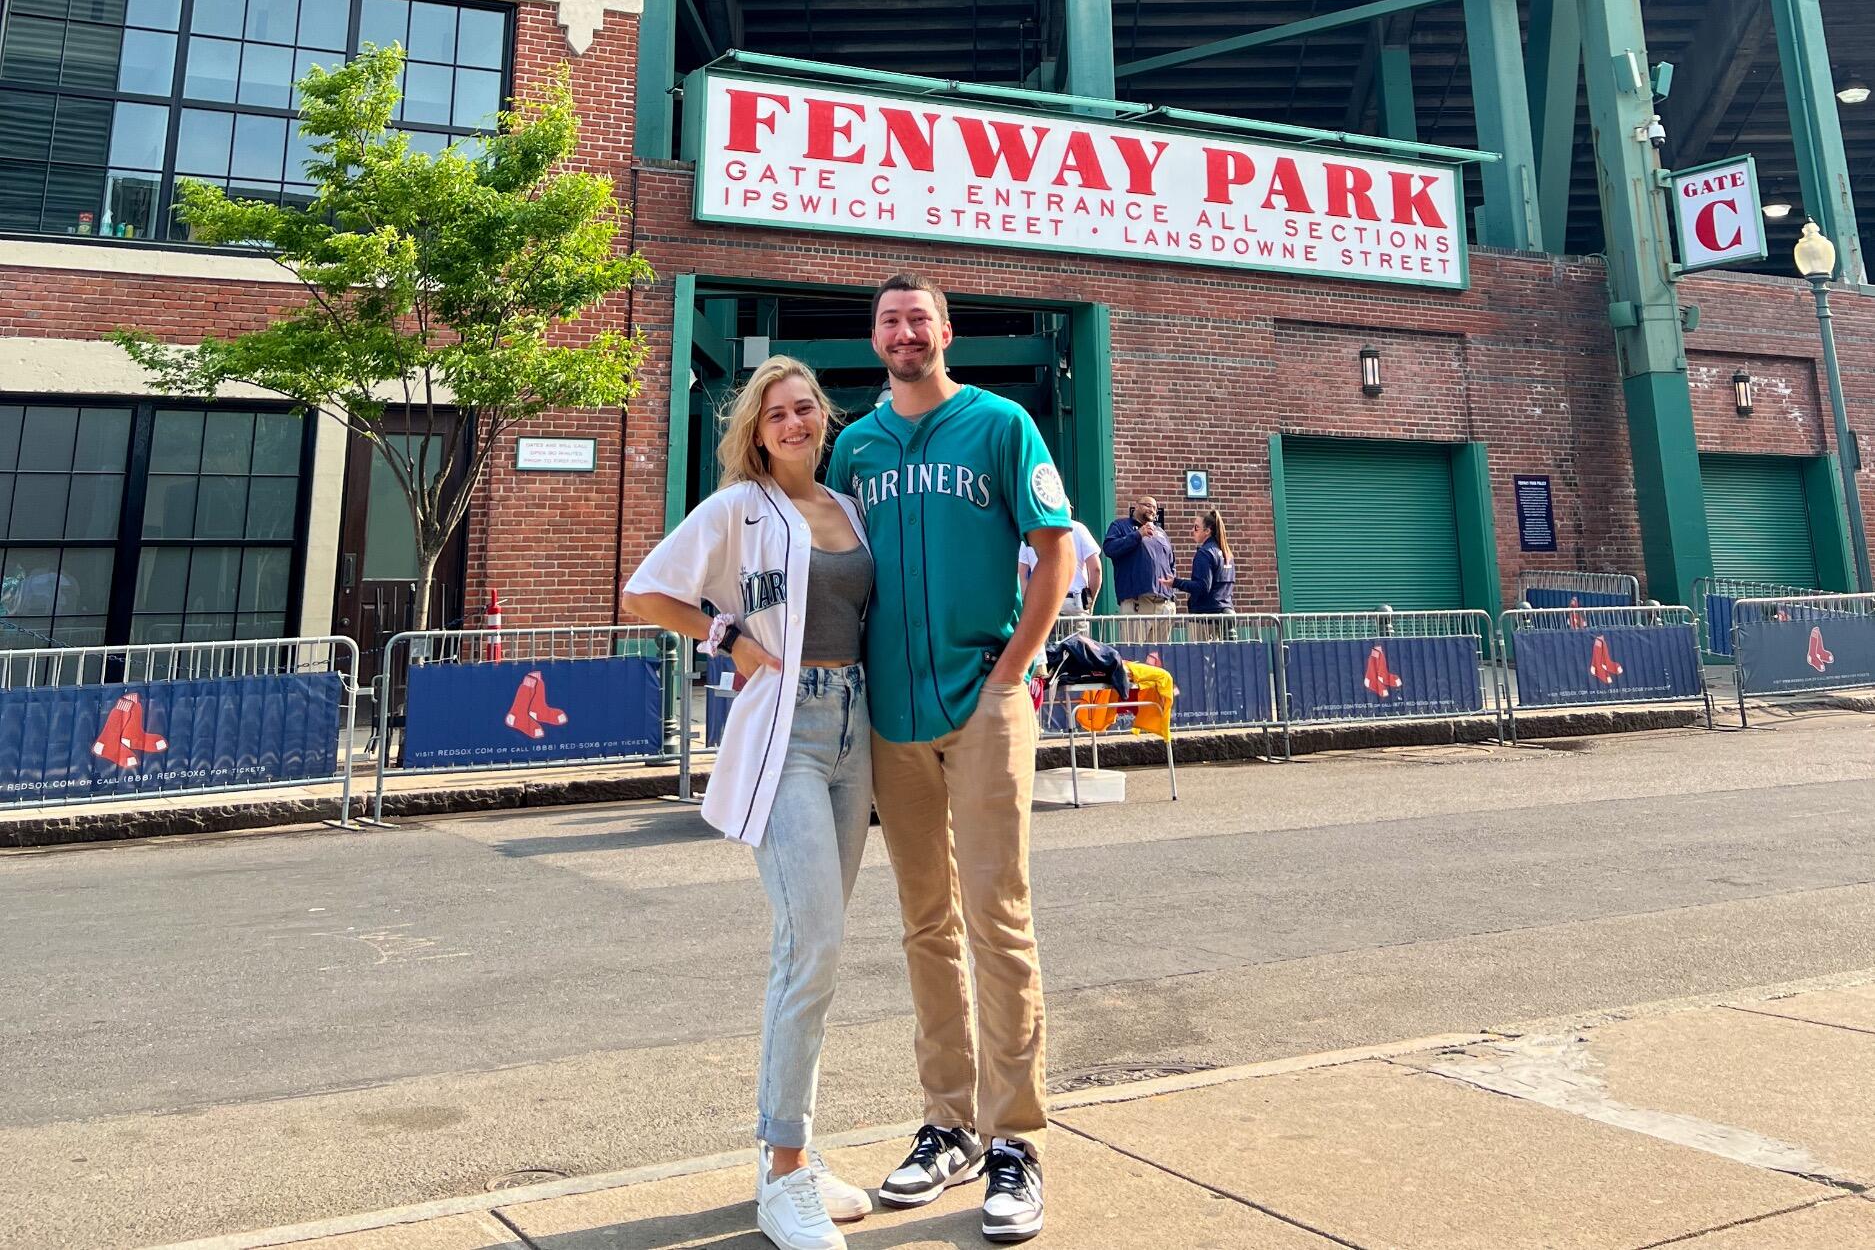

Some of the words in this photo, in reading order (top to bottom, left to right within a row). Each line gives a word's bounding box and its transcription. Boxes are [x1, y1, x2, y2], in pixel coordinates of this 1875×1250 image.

[723, 87, 1169, 196] FENWAY
[1202, 146, 1448, 230] PARK
[1682, 171, 1745, 198] GATE
[723, 186, 895, 222] IPSWICH
[926, 206, 1064, 237] STREET
[1124, 226, 1318, 262] LANSDOWNE
[1340, 248, 1450, 275] STREET
[724, 159, 836, 191] GATE
[871, 174, 891, 195] C
[967, 184, 1169, 224] ENTRANCE
[1196, 209, 1258, 234] ALL
[1284, 218, 1450, 254] SECTIONS
[1695, 197, 1743, 252] C
[79, 779, 93, 787] OR
[97, 776, 120, 786] CALL
[210, 768, 228, 776] FOR
[232, 765, 266, 774] TICKETS
